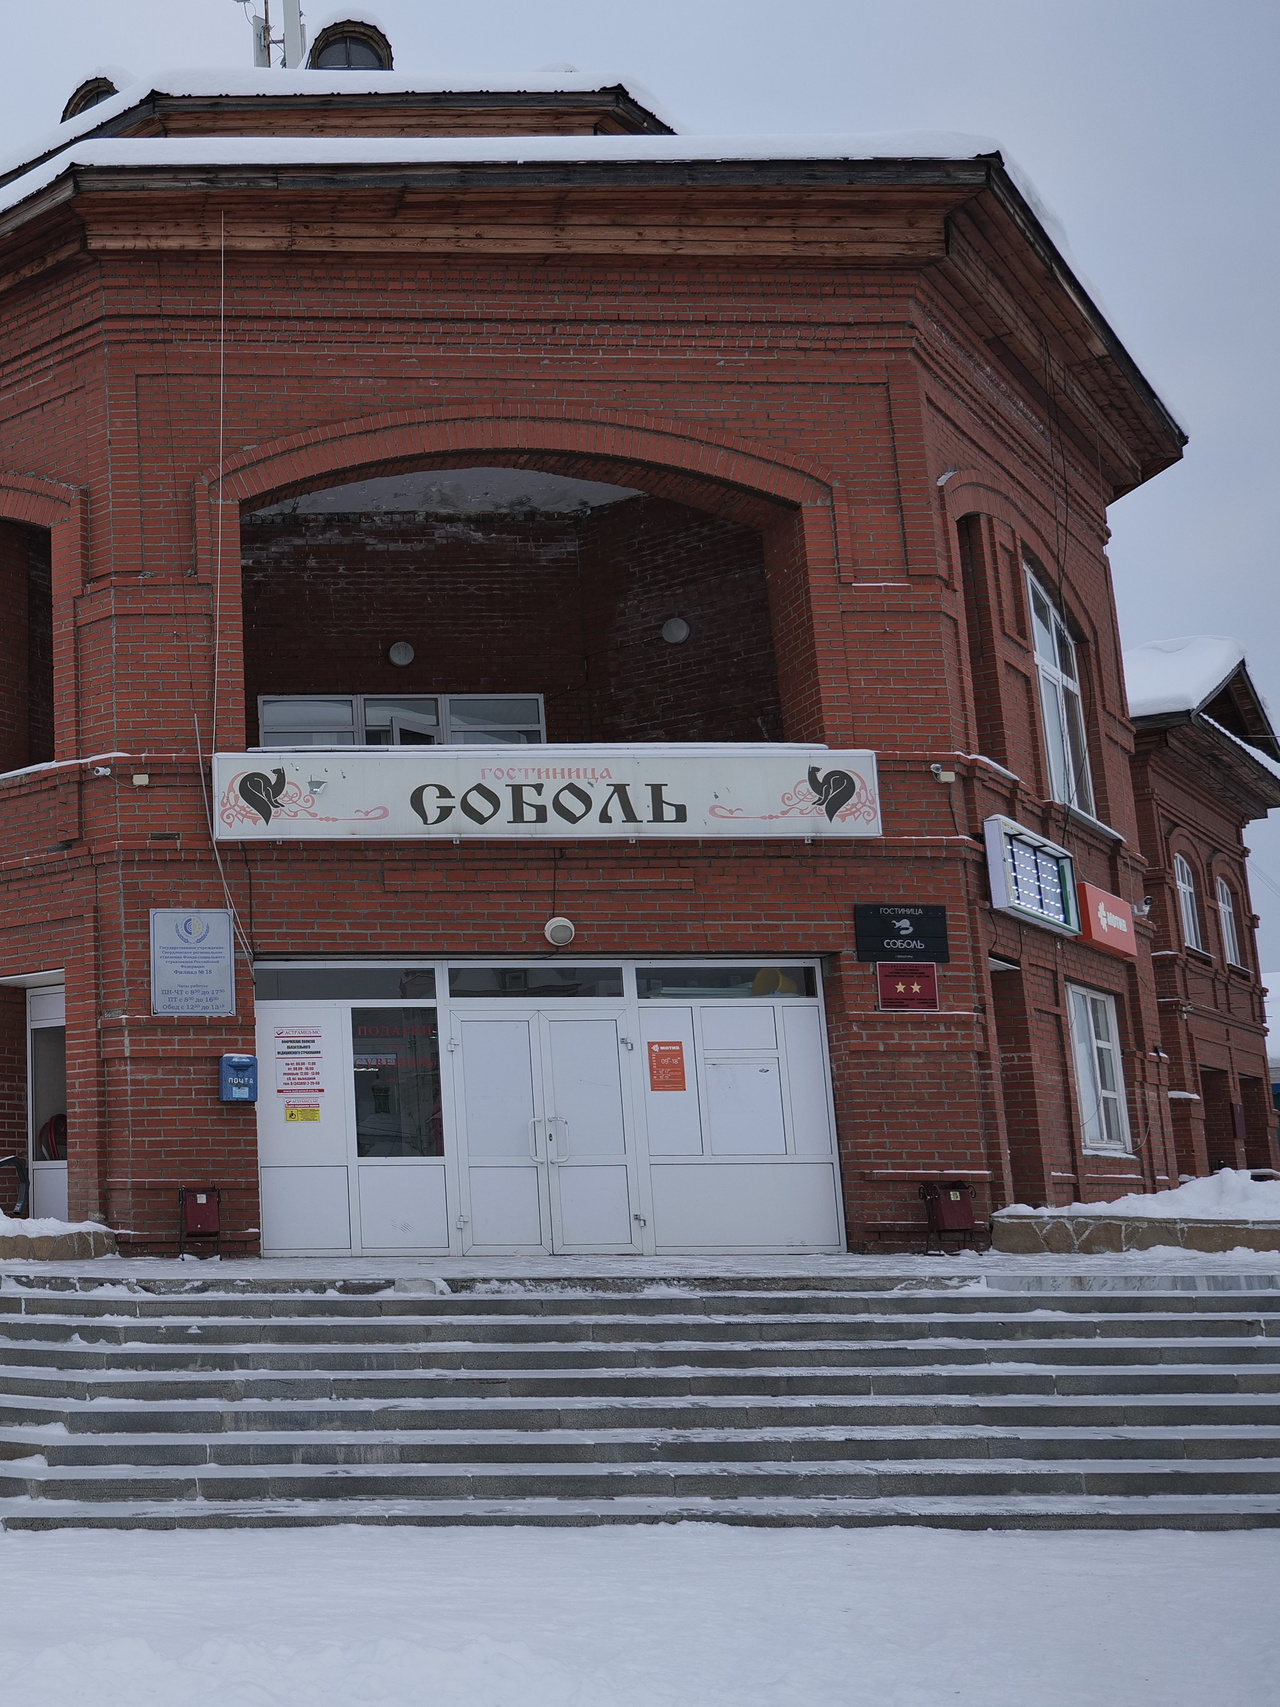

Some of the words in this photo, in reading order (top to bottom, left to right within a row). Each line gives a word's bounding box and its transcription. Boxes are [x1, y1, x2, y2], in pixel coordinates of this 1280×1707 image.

[409, 782, 688, 826] СОБОЛЬ
[879, 907, 924, 915] ГОСТИНИЦА
[883, 939, 925, 949] СОБОЛЬ
[357, 1025, 433, 1036] ПОДАРКИ
